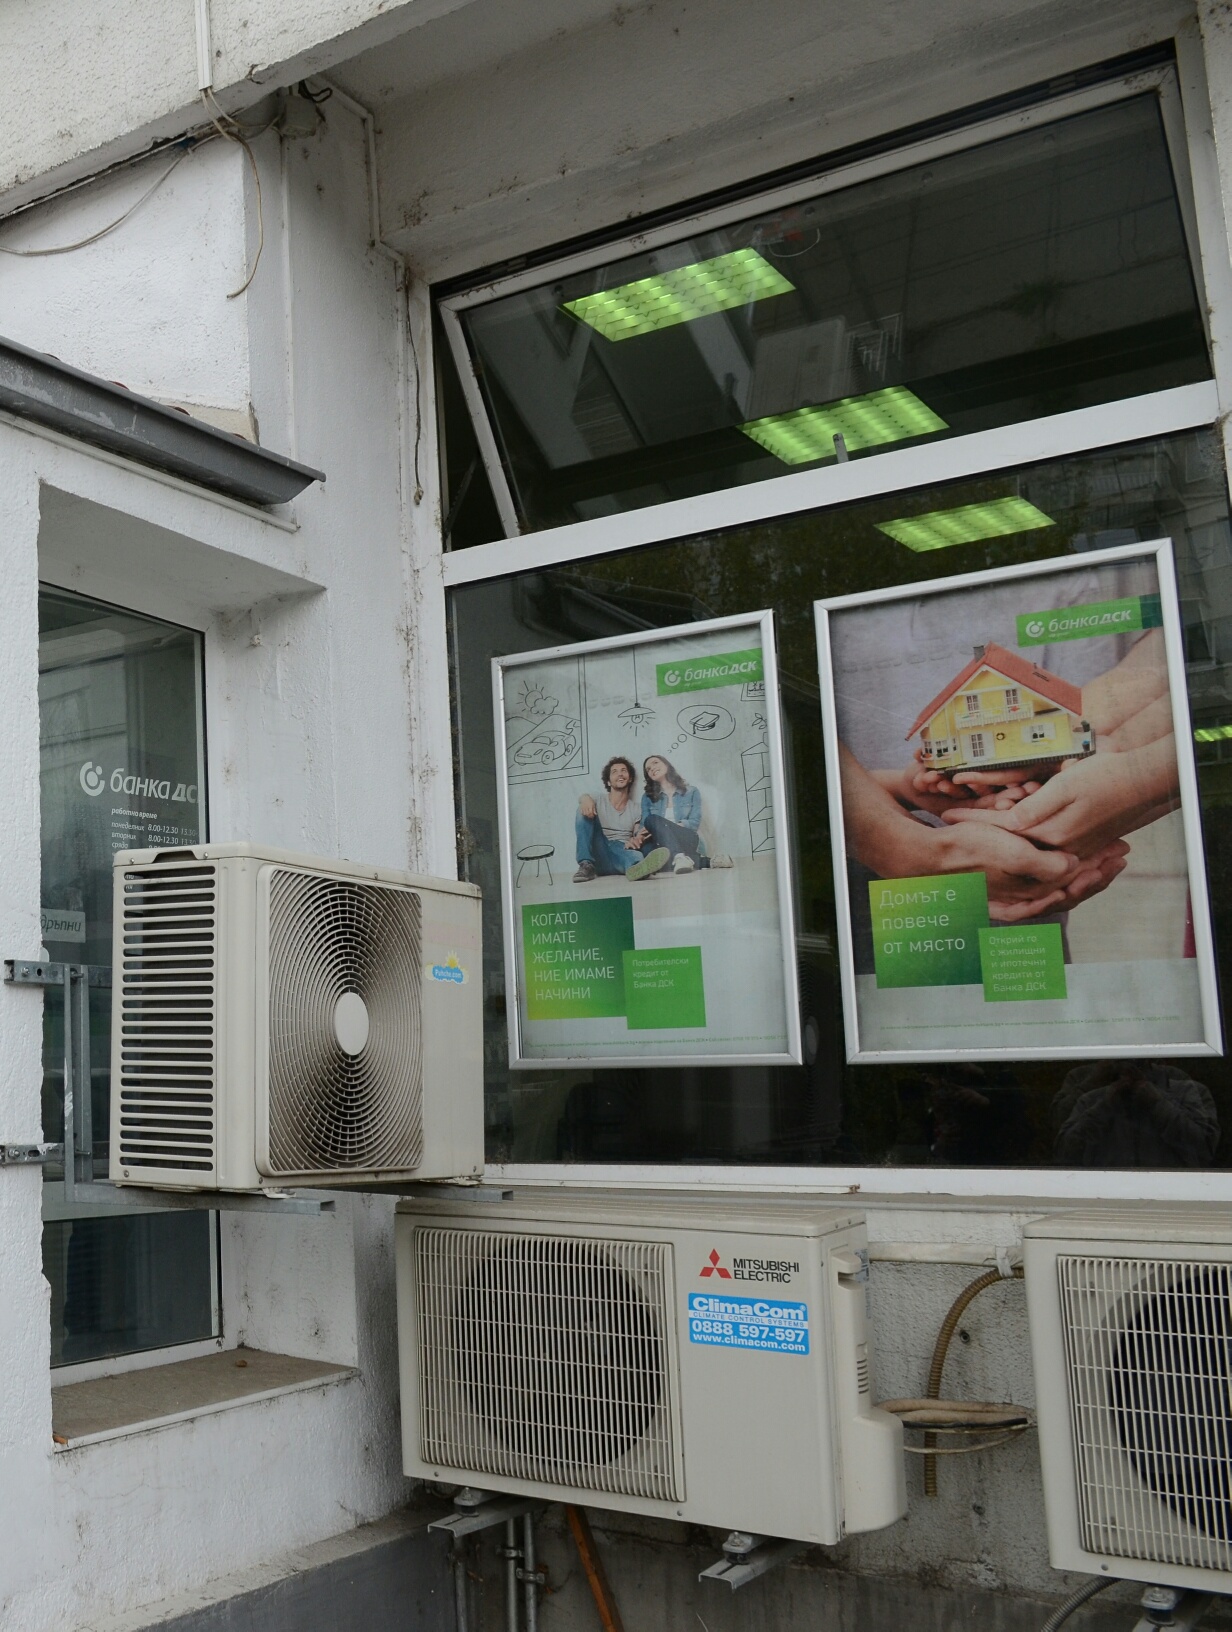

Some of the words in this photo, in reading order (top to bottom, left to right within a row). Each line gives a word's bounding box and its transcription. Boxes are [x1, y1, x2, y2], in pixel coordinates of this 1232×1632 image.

[148, 824, 179, 834] 8.00-12.30
[111, 832, 137, 840] вторник
[148, 835, 179, 845] 8.00-12.30
[880, 889, 940, 908] Домът
[945, 889, 957, 902] е
[531, 911, 579, 927] КОГАТО
[882, 914, 950, 930] повече
[532, 930, 577, 945] ИМАТЕ
[989, 935, 1025, 946] Открий
[883, 941, 903, 954] от
[910, 938, 966, 953] място
[998, 947, 1046, 957] жилищни
[632, 957, 689, 967] Потребителски
[1000, 960, 1046, 968] ипотечни
[534, 969, 561, 983] НИЕ
[565, 966, 615, 981] ИМАМЕ
[633, 970, 659, 979] кредит
[992, 972, 1032, 981] кредити
[634, 980, 657, 989] Банка
[658, 979, 674, 989] ДСК
[994, 983, 1023, 992] Банка
[1025, 982, 1047, 991] ДСК
[536, 987, 591, 1001] НАЧИНИ
[733, 1258, 800, 1273] MITSUBISHI
[734, 1269, 791, 1284] ELECTRIC
[693, 1311, 725, 1320] CLIMATE
[728, 1315, 765, 1324] CONTROL
[768, 1318, 805, 1328] SYSTEMS
[692, 1319, 733, 1335] 0888
[739, 1324, 805, 1342] 597-597
[693, 1333, 806, 1352] www.climacom.com
